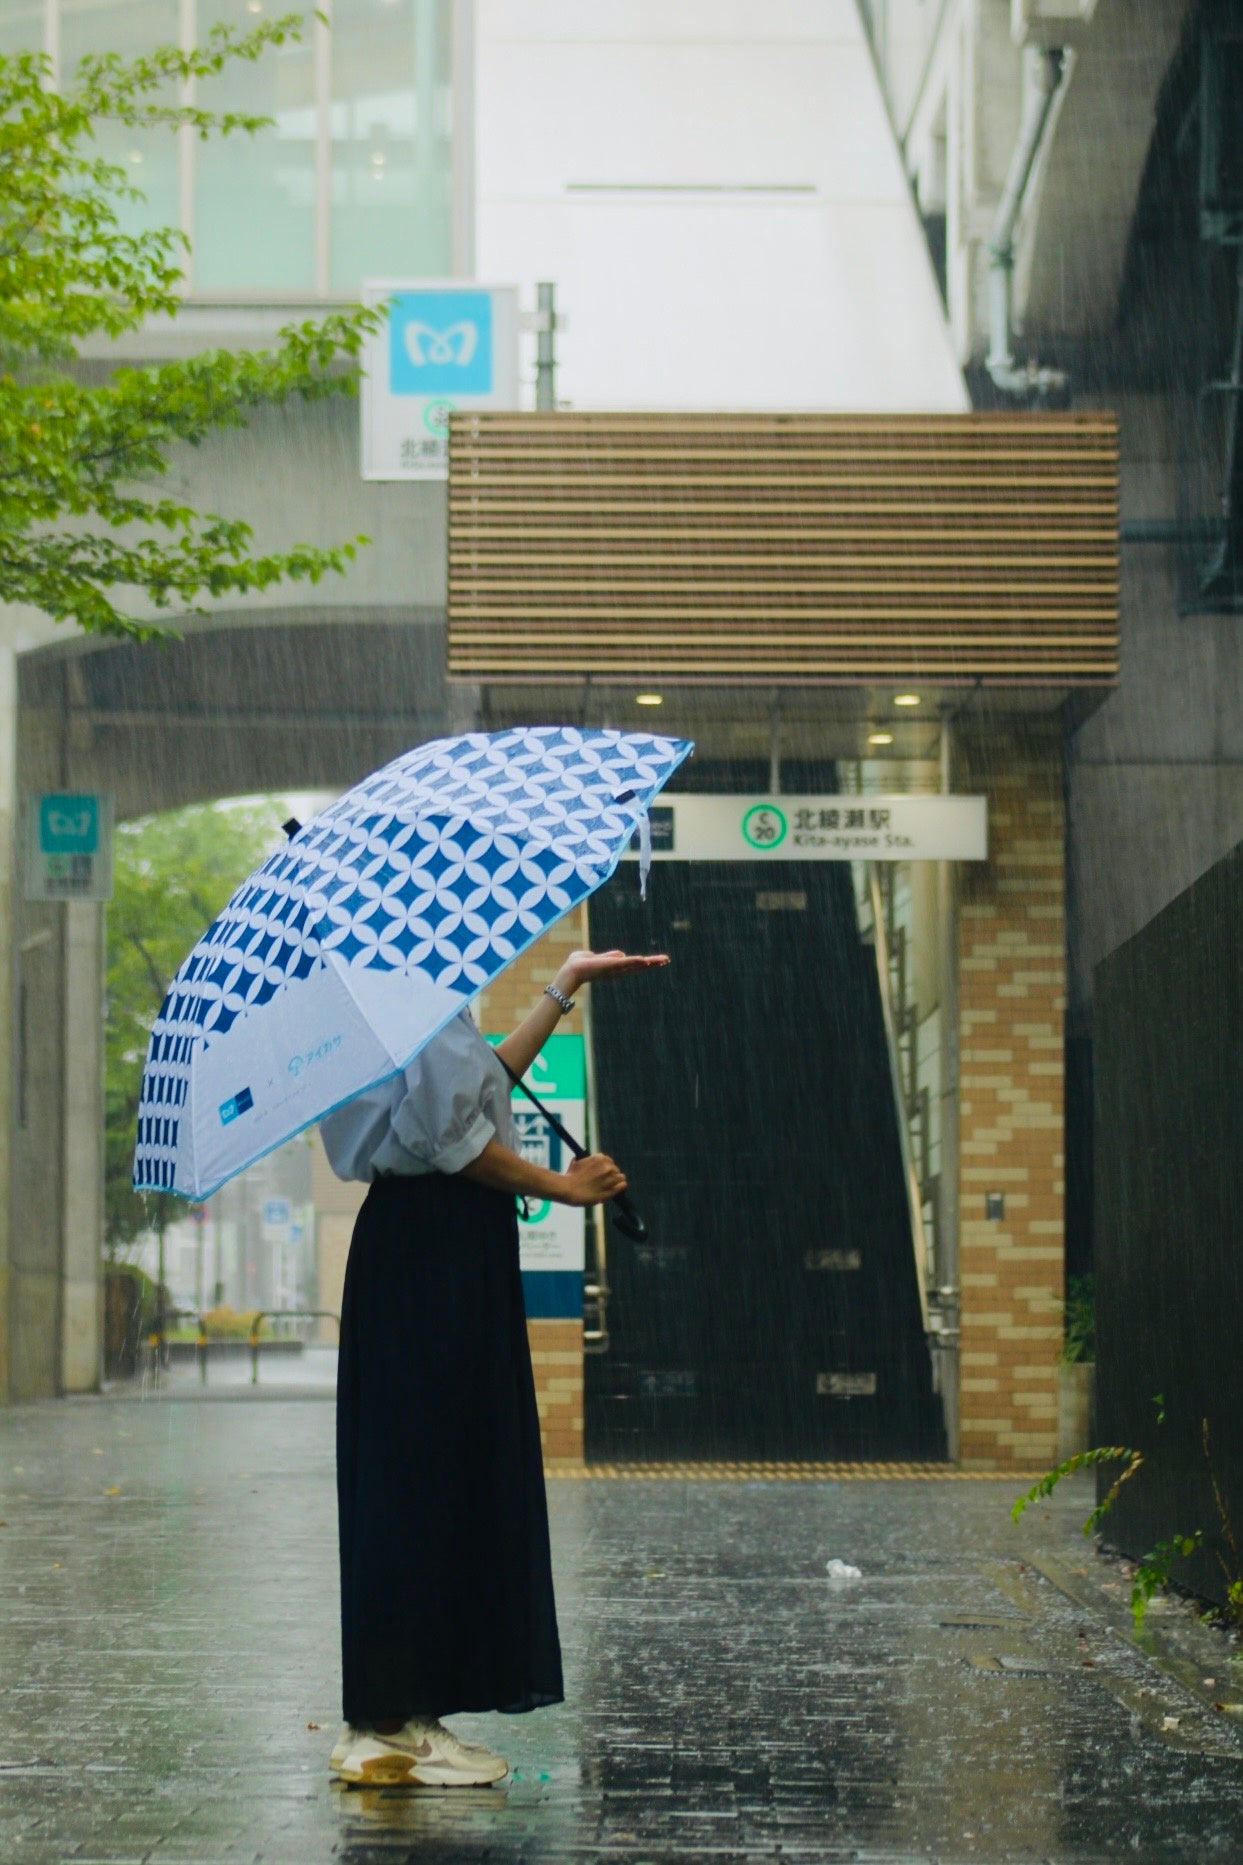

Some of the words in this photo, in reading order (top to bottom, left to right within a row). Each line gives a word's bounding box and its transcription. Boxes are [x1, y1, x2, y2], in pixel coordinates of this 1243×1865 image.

[759, 812, 769, 825] C
[793, 808, 890, 830] 北綾瀬駅
[755, 826, 775, 840] 20
[794, 834, 878, 848] Kita-ayase
[886, 834, 914, 848] Sta.
